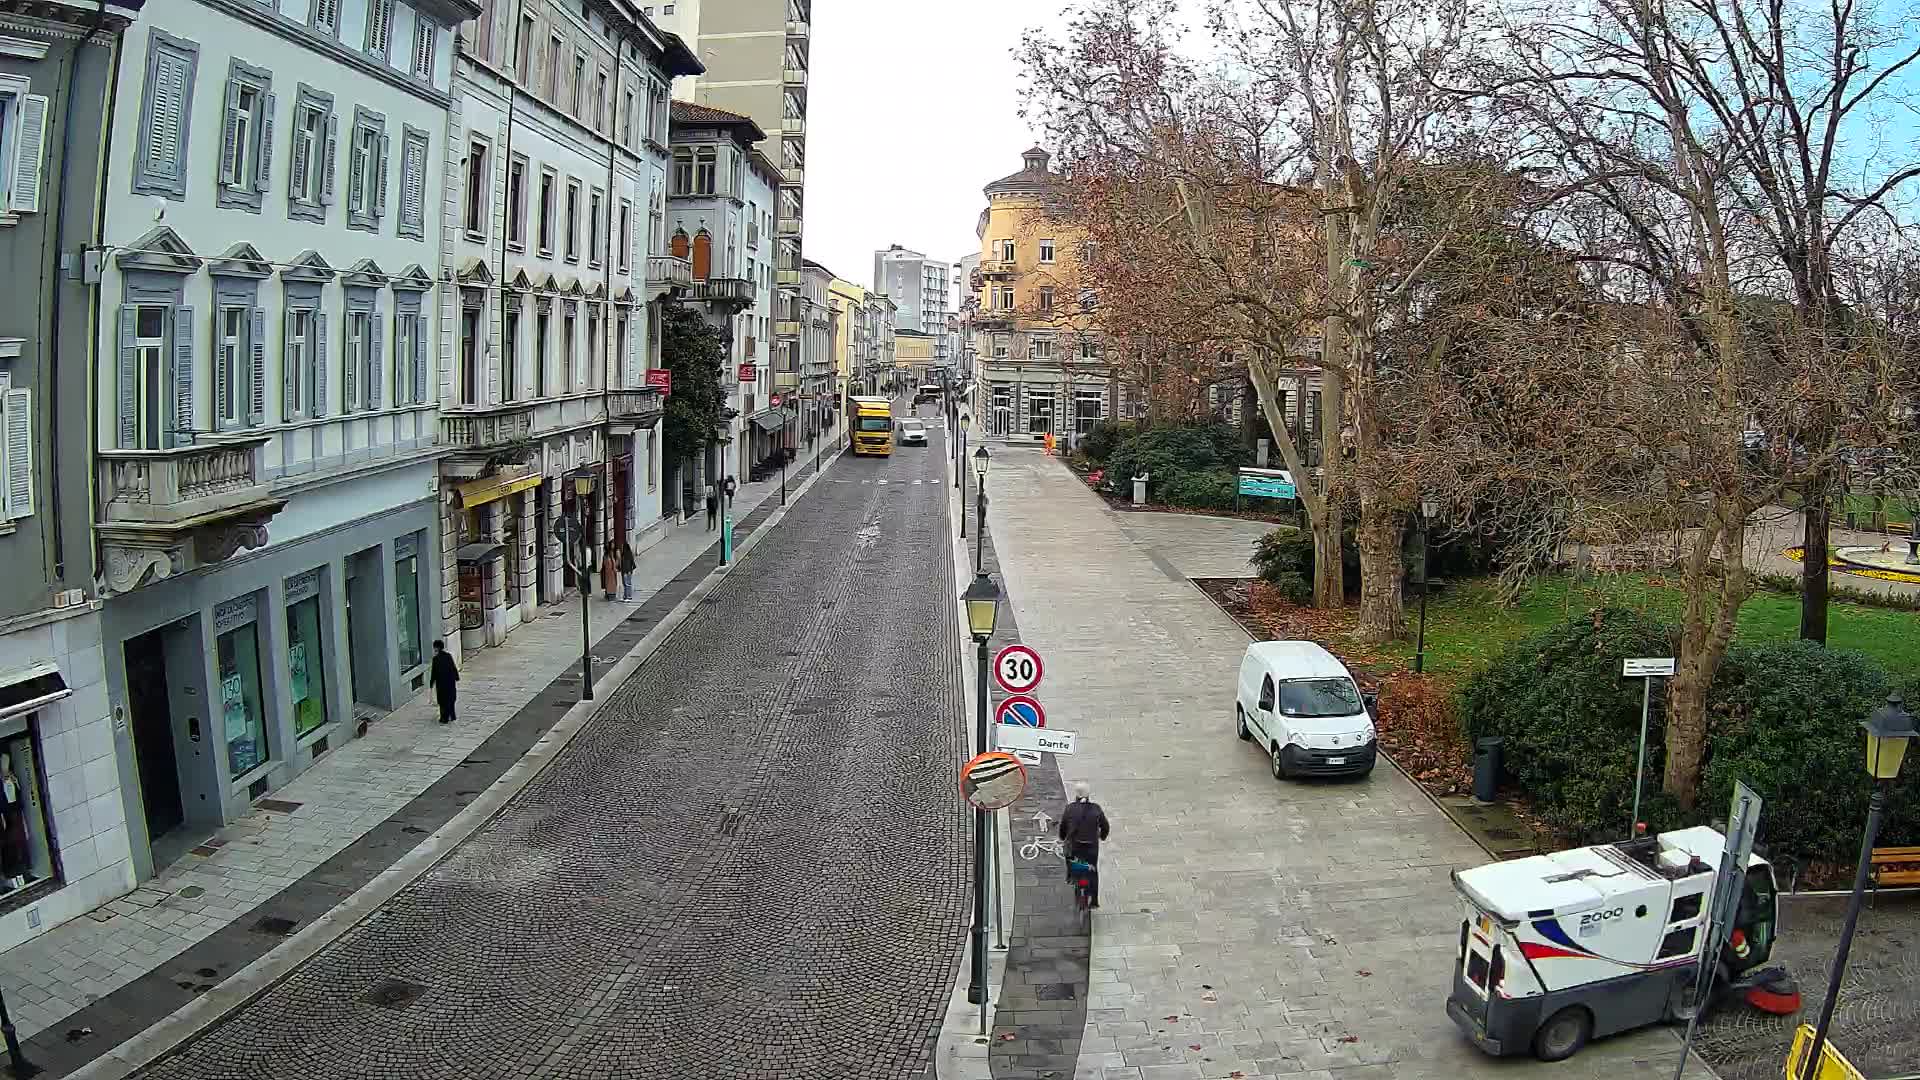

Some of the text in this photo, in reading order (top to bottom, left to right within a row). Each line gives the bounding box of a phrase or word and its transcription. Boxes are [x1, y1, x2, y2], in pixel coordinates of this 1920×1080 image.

[1005, 659, 1033, 680] 30
[1038, 738, 1070, 750] Dante
[1580, 907, 1624, 924] 2000
